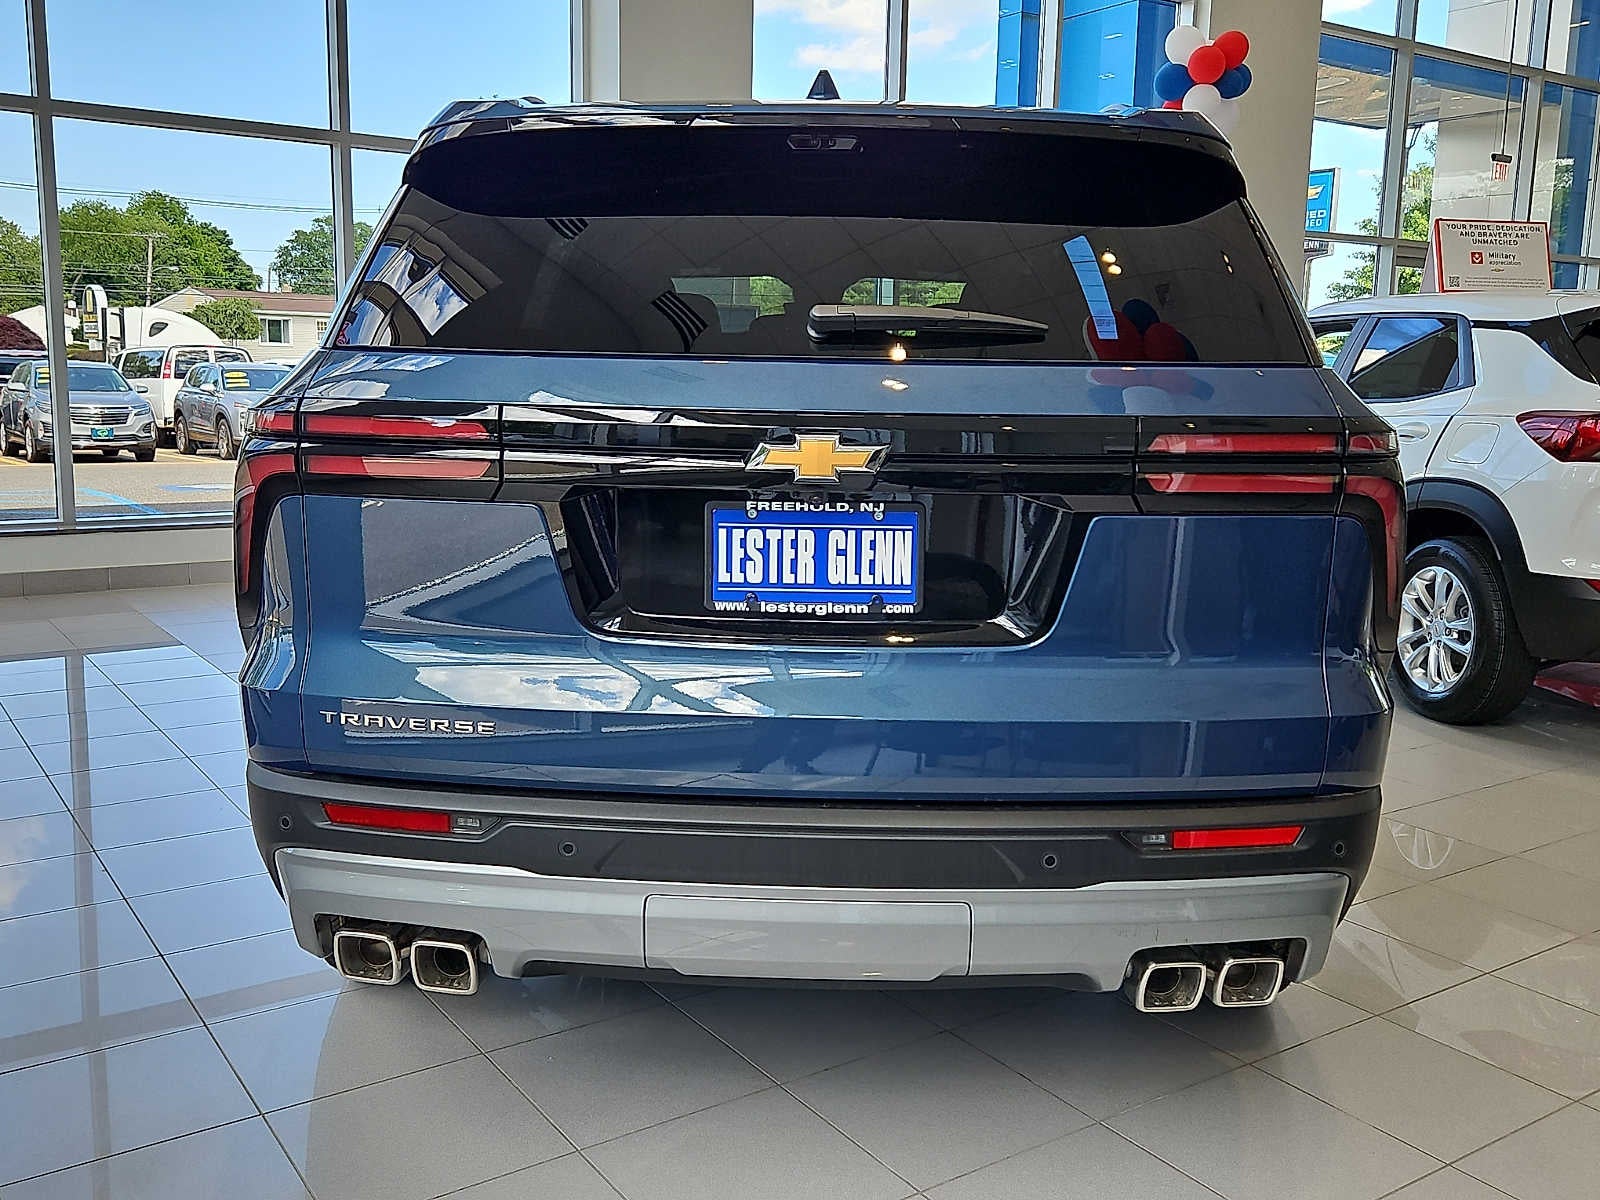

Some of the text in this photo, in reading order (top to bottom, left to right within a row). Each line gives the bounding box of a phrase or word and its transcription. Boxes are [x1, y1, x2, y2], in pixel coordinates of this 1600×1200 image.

[1494, 163, 1508, 181] EXIT
[1306, 209, 1327, 219] ED
[1306, 218, 1322, 227] ED
[1446, 223, 1467, 231] YOUR
[1477, 231, 1512, 239] BRAVERY
[1472, 238, 1519, 246] UNMATCHED
[1488, 252, 1517, 260] Military
[746, 501, 885, 513] FREEHOLD, NJ
[717, 527, 913, 586] LESTER GLENN
[713, 601, 914, 616] www. lesterglenn .com
[319, 710, 497, 735] TRAVERSE
